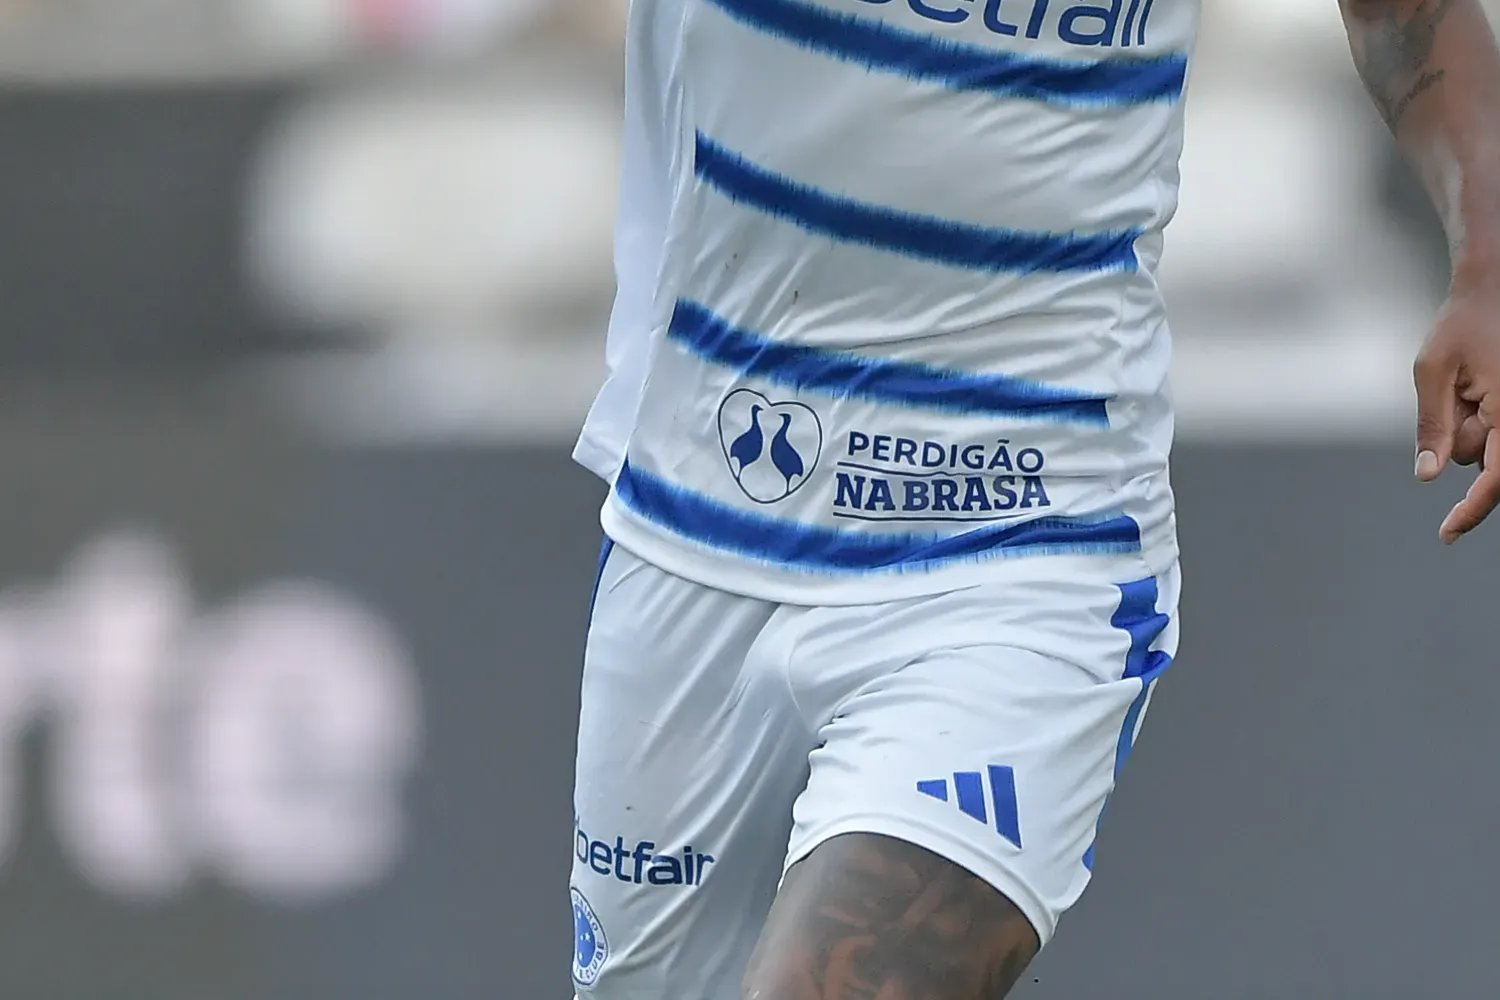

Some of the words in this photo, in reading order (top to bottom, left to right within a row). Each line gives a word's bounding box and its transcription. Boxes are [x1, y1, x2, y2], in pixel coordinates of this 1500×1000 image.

[847, 431, 1044, 474] PERDIGÃO
[833, 472, 896, 513] NA
[902, 475, 1051, 513] BRASA
[575, 815, 715, 886] betfair
